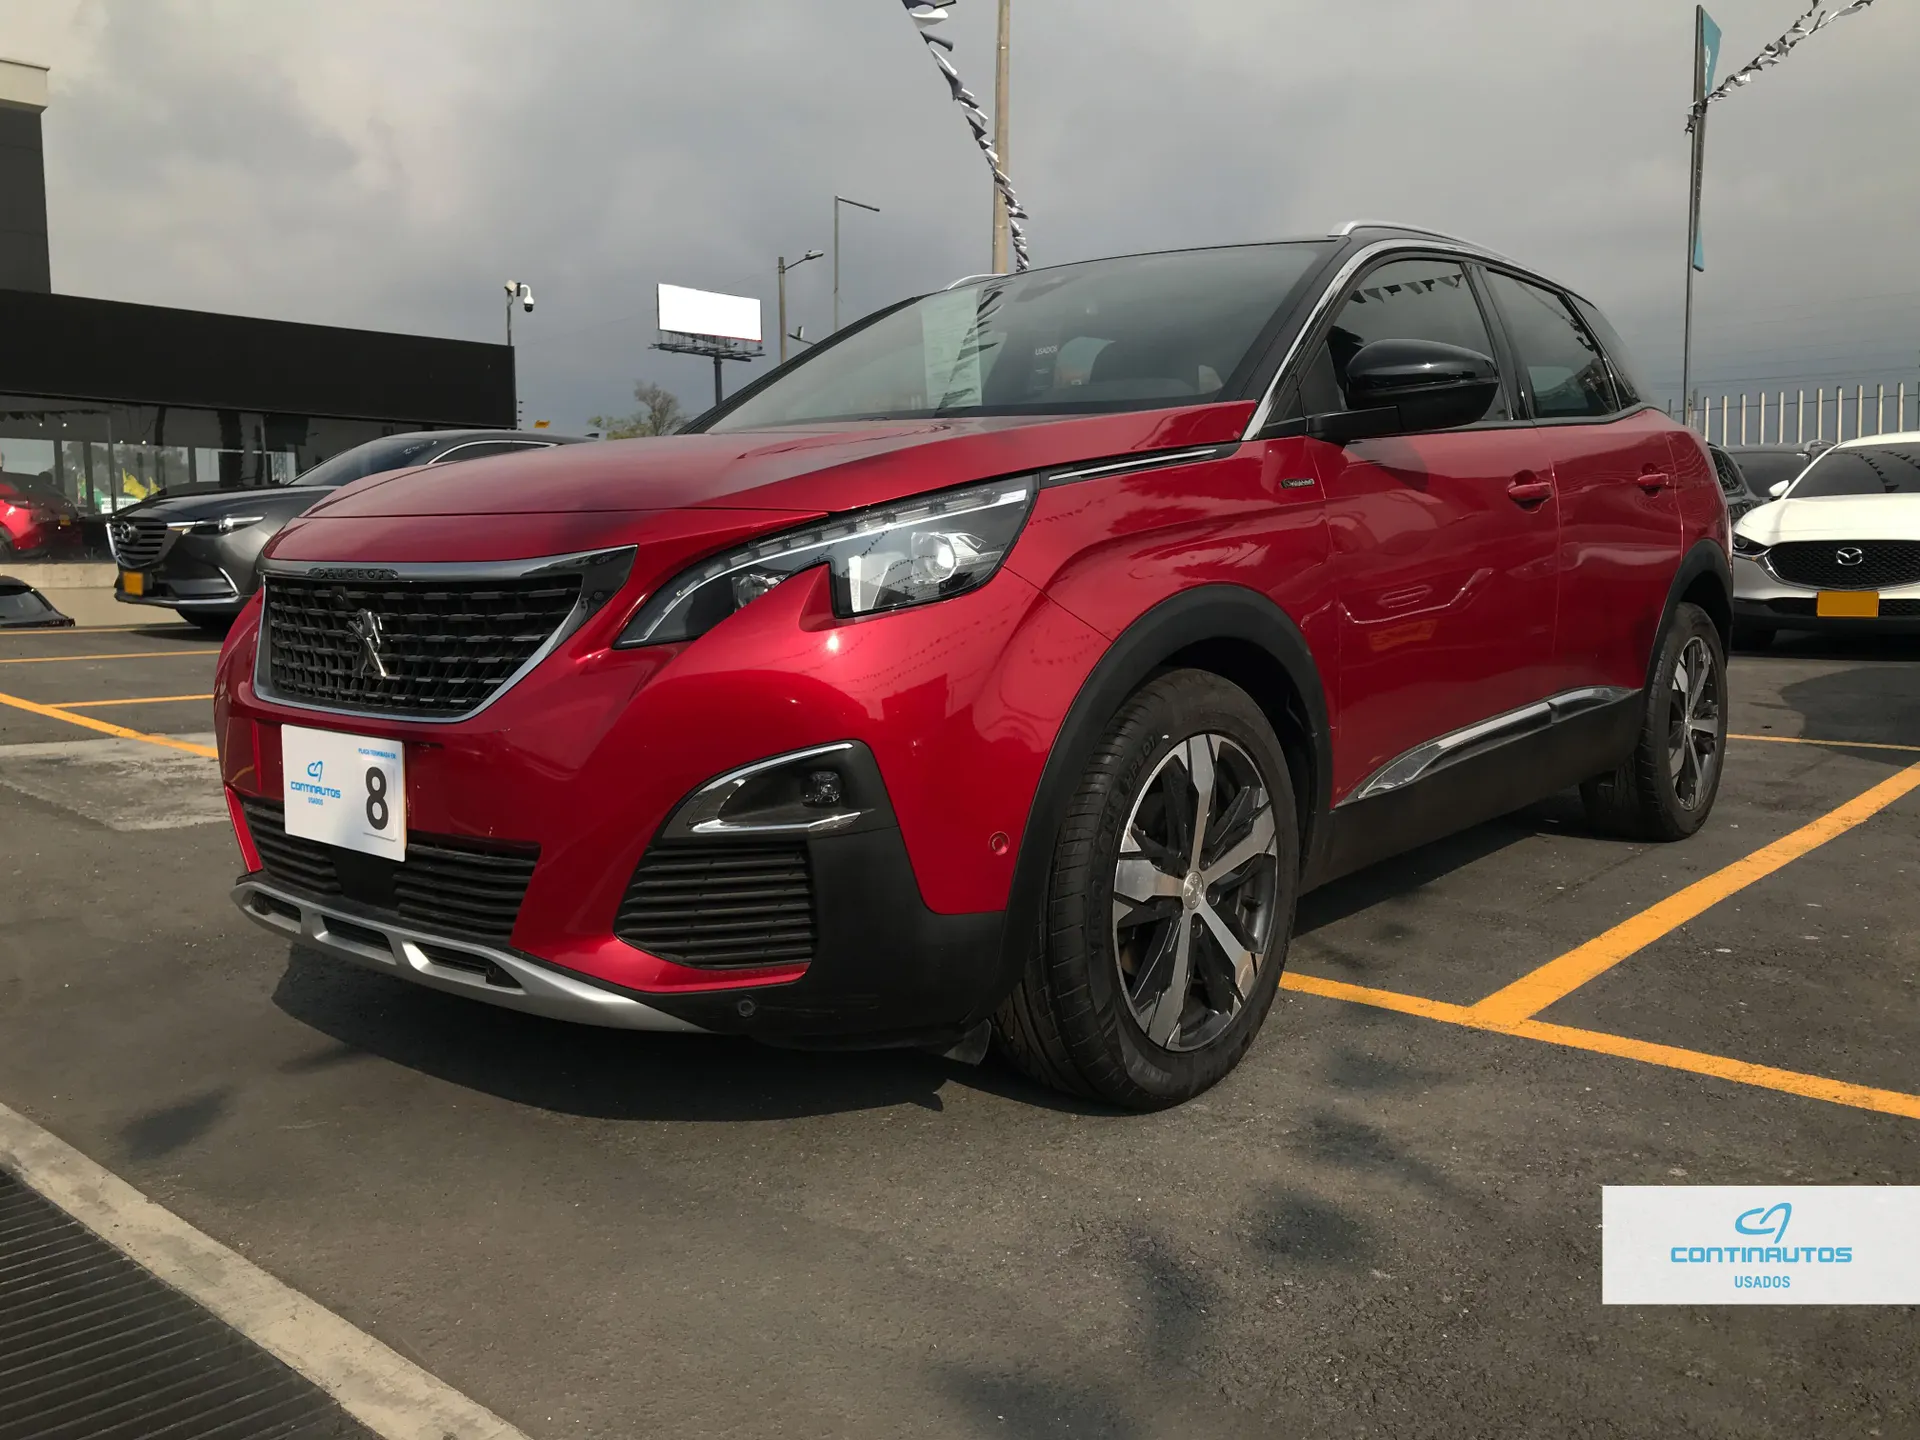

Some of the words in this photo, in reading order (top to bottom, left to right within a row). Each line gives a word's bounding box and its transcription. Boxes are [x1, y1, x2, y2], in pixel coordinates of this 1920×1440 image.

[319, 568, 385, 580] PEUGEOT
[290, 781, 341, 799] CONTINAUTOS
[365, 766, 389, 831] 8
